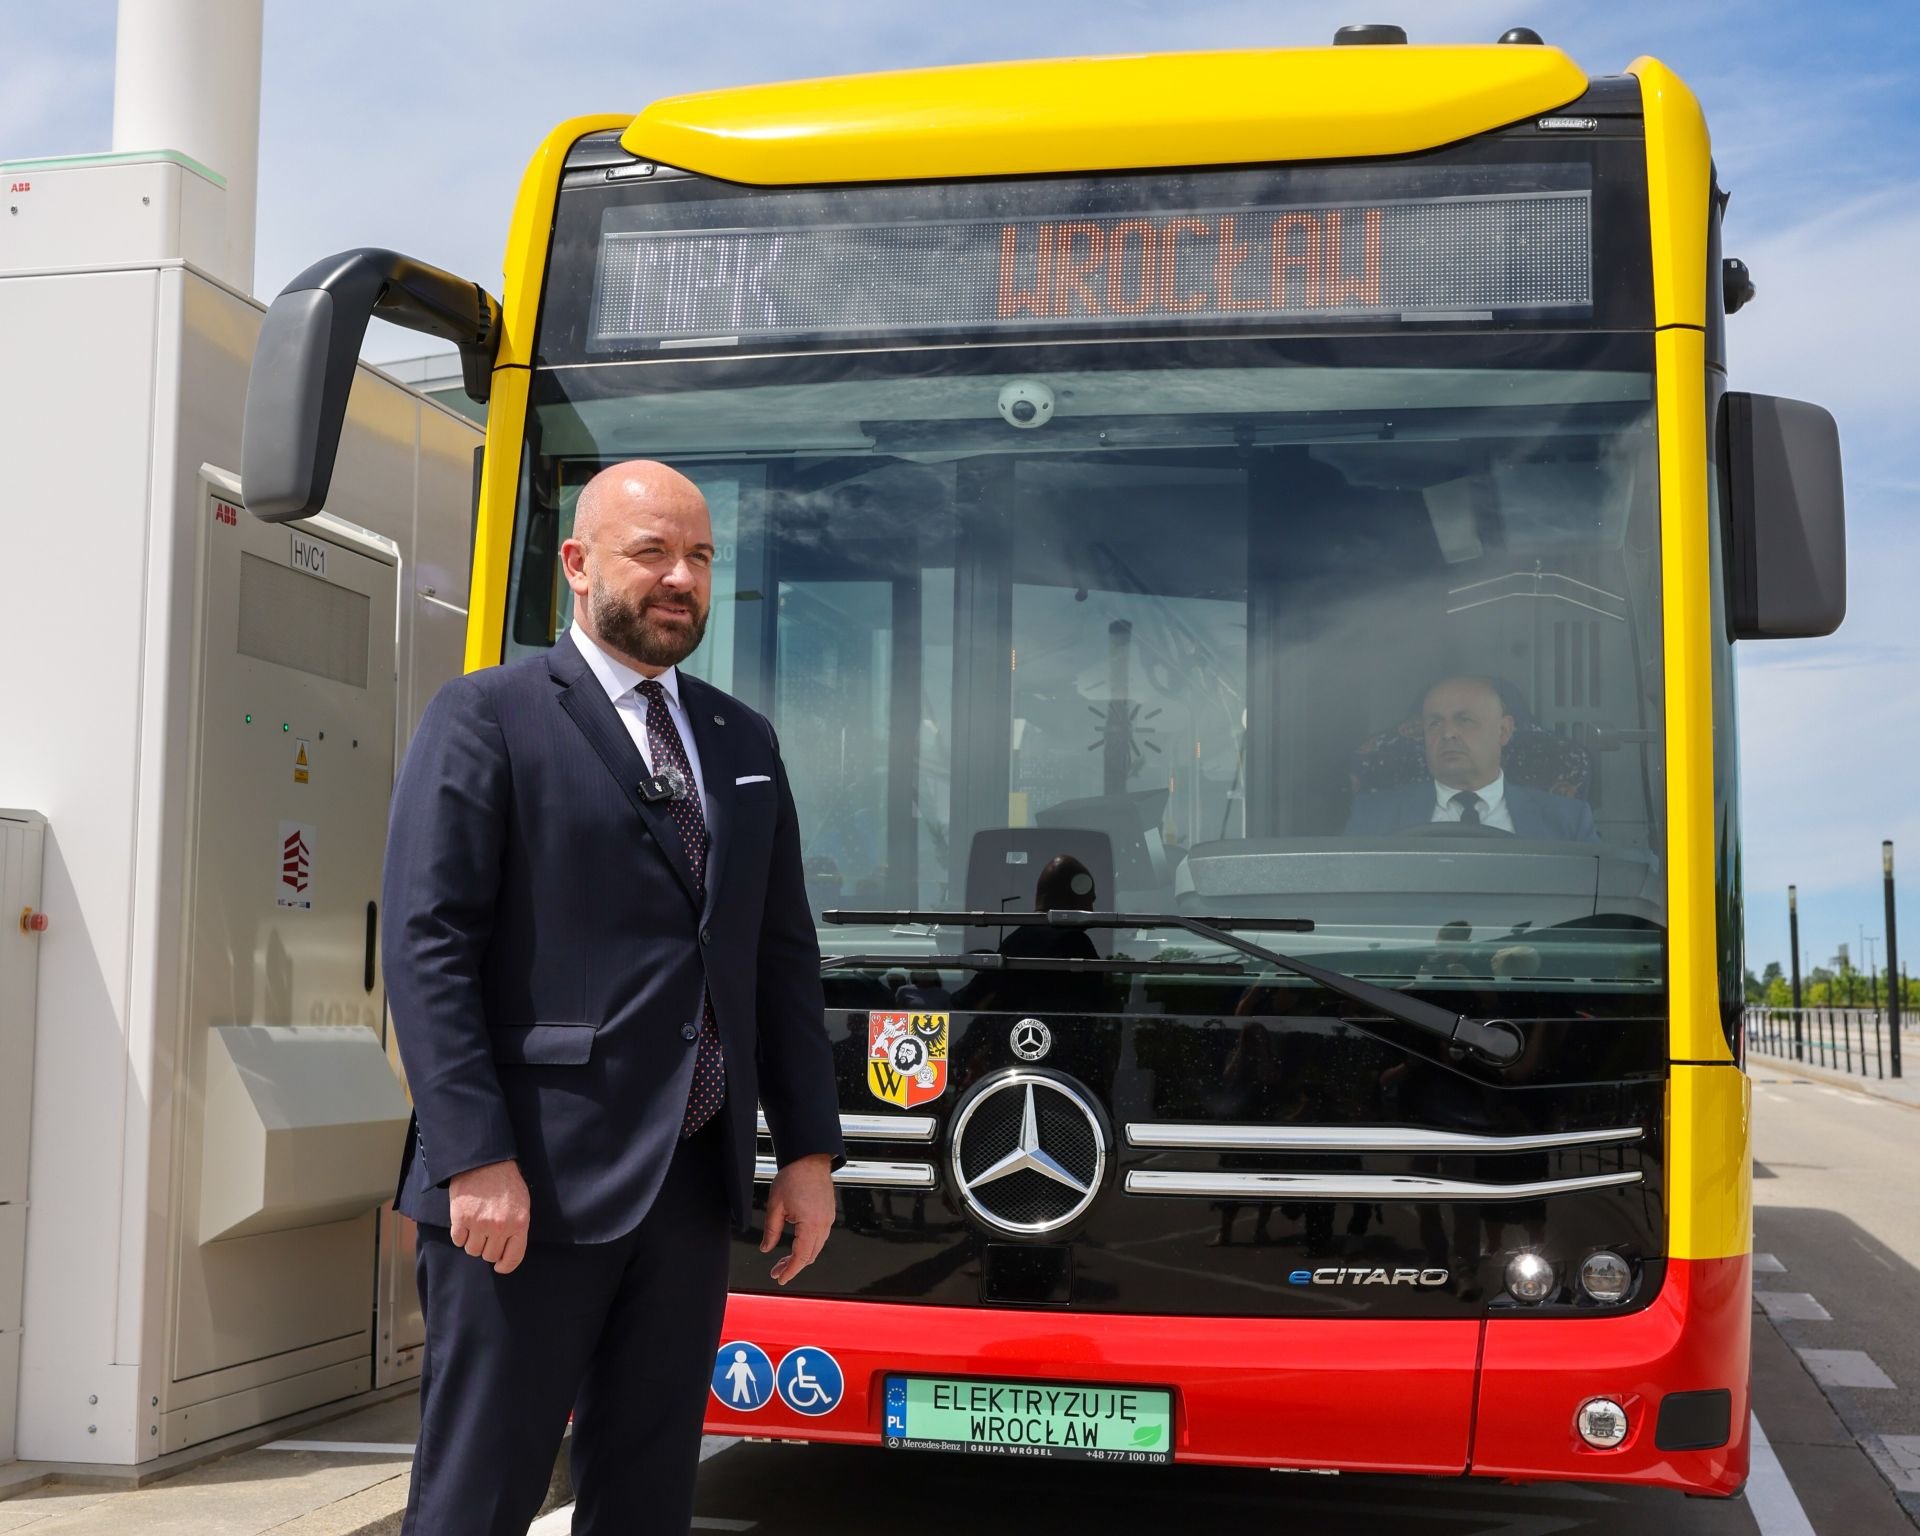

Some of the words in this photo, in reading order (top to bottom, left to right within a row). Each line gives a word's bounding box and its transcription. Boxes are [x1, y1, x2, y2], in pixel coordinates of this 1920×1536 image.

[11, 182, 30, 192] ABB
[997, 208, 1382, 319] WROCŁAW
[215, 502, 237, 527] ABB
[294, 539, 325, 574] HVC1
[1288, 1267, 1449, 1286] eCITARO
[933, 1384, 1137, 1423] ELEKTRYZUJĘ
[887, 1415, 904, 1429] PL
[970, 1415, 1099, 1448] WROCŁAW
[902, 1438, 961, 1452] Mercedes-Benz
[970, 1444, 1006, 1454] GRUPA
[1009, 1444, 1053, 1457] WRÓBEL
[1086, 1450, 1105, 1460] +48
[1106, 1450, 1125, 1461] 777
[1128, 1451, 1146, 1462] 100
[1148, 1452, 1166, 1463] 100
